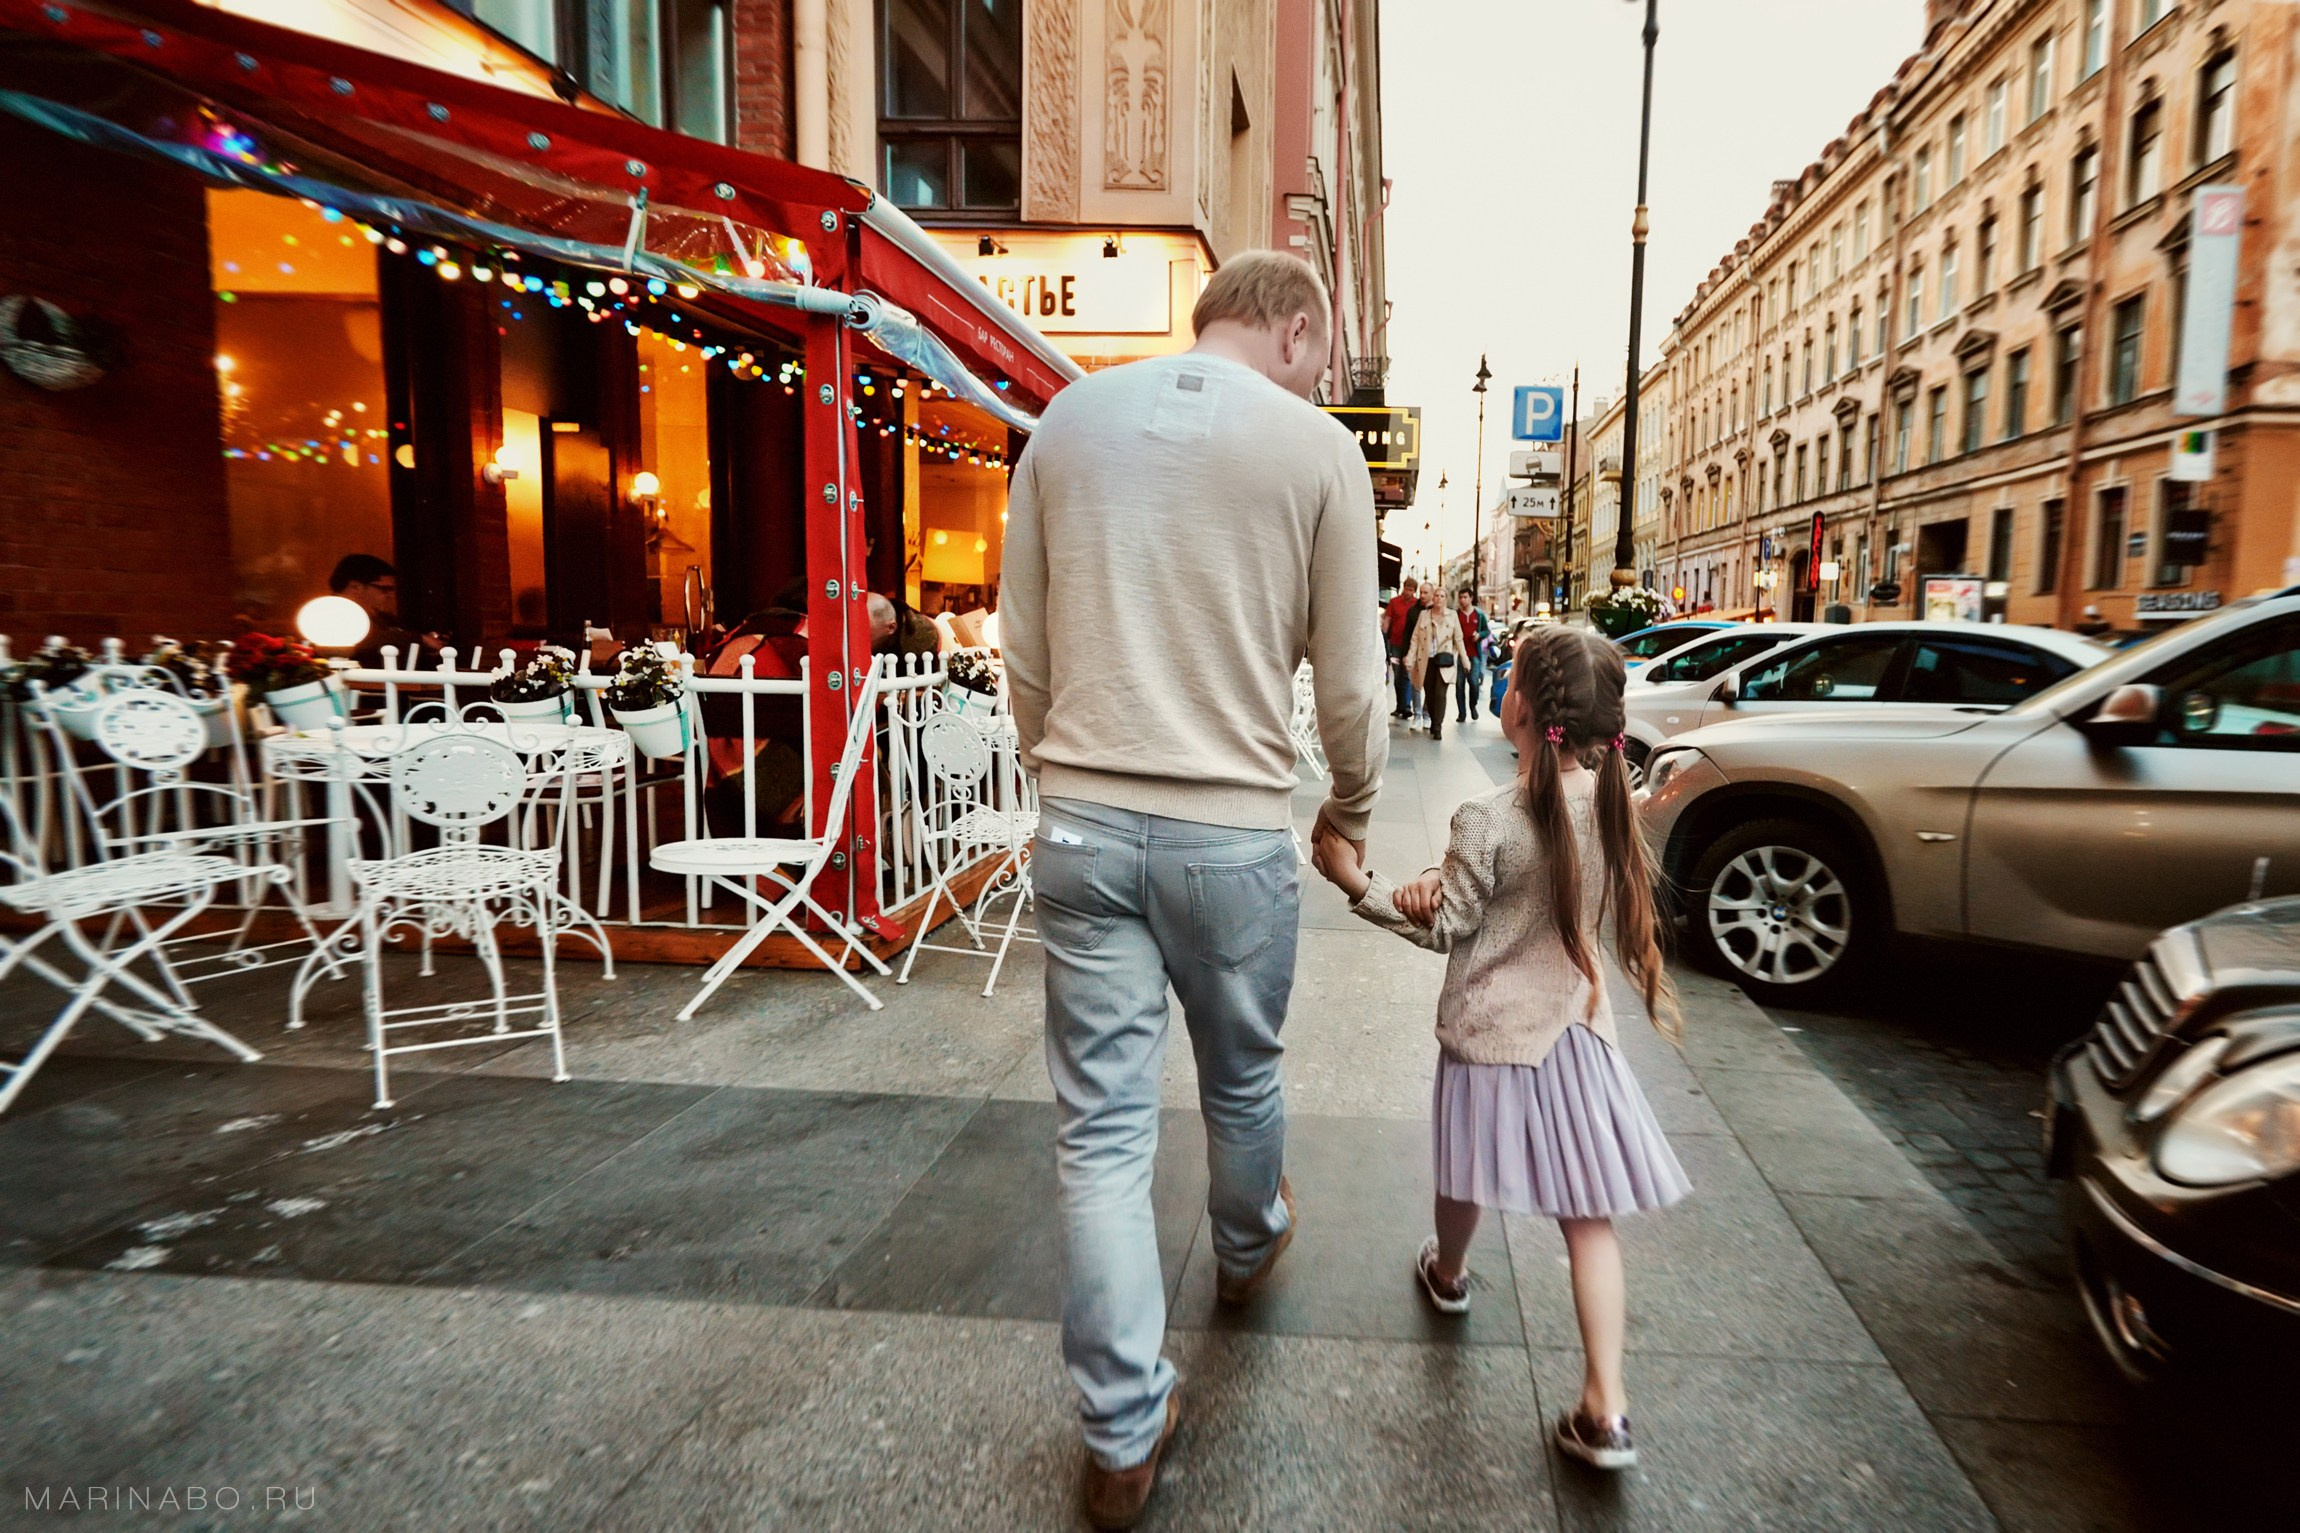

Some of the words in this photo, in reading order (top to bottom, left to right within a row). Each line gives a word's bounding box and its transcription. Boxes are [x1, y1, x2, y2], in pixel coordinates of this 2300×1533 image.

[978, 326, 988, 344] БАР
[990, 334, 1014, 363] РЕСТОРАН
[1525, 391, 1555, 435] P
